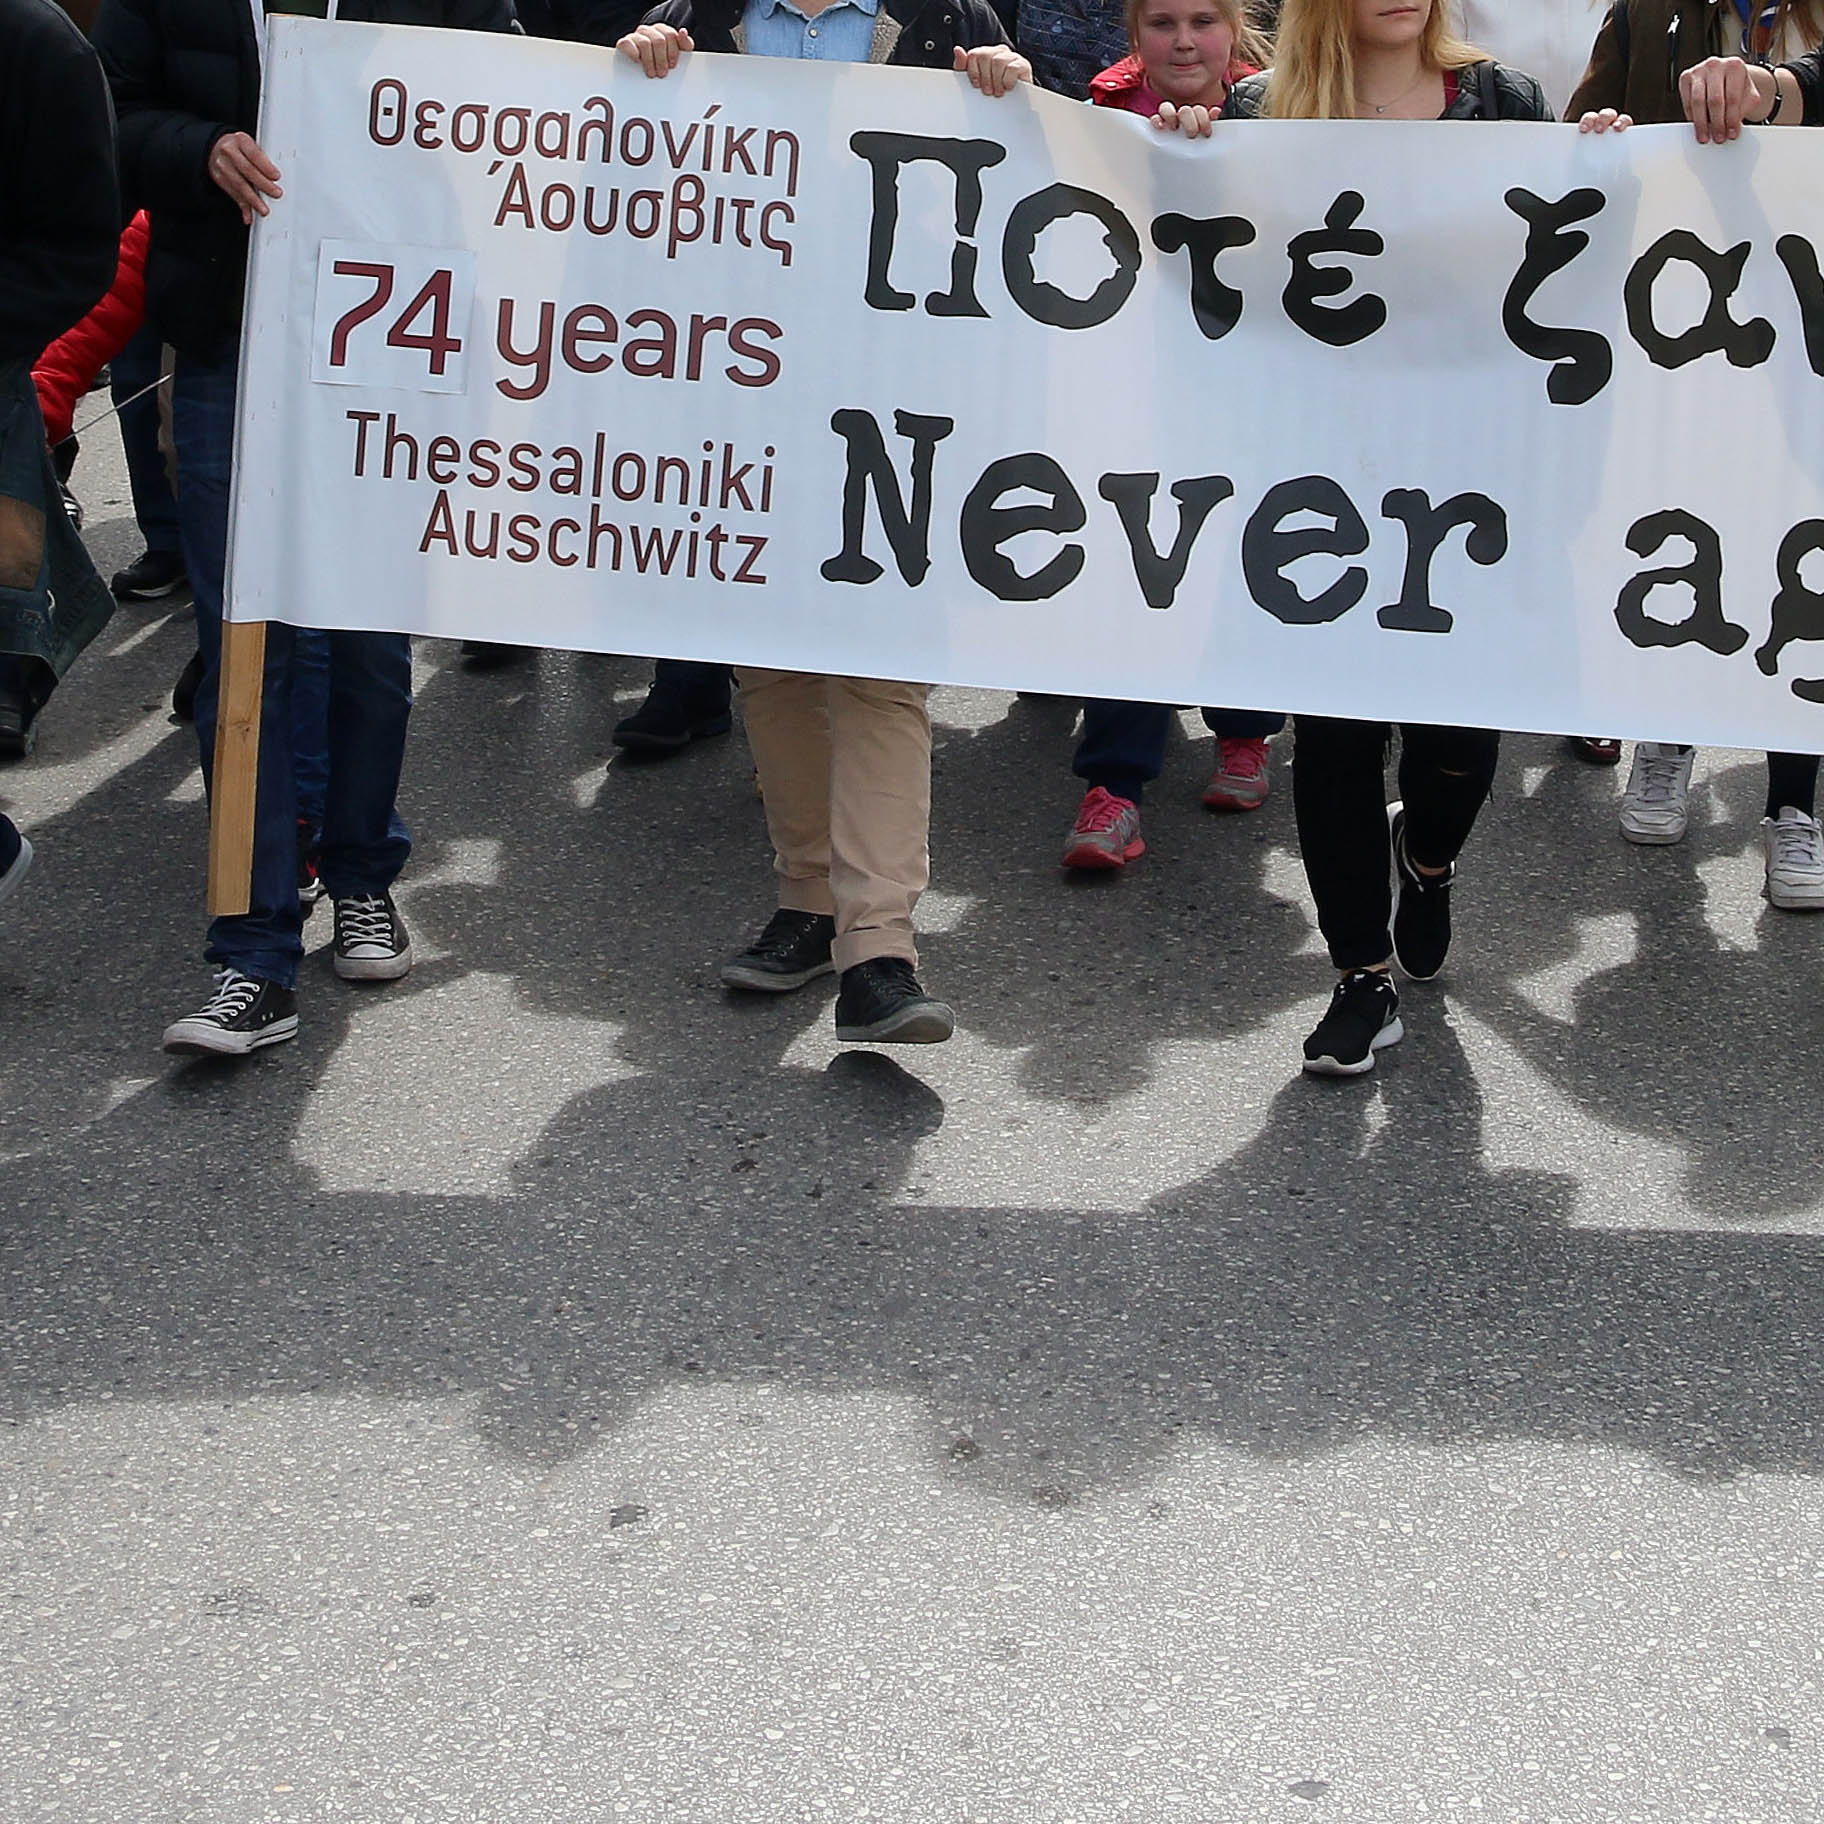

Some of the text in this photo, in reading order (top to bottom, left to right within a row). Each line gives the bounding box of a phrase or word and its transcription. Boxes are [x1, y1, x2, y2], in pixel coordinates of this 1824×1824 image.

[368, 78, 800, 197] Θεσσαλονίκη
[486, 159, 795, 267] Άουσβιτς
[849, 130, 1387, 347] Ποτέ
[329, 260, 783, 401] 74 years
[346, 410, 773, 513] Thessaloniki
[820, 408, 1508, 634] Never
[418, 489, 769, 585] Auschwitz
